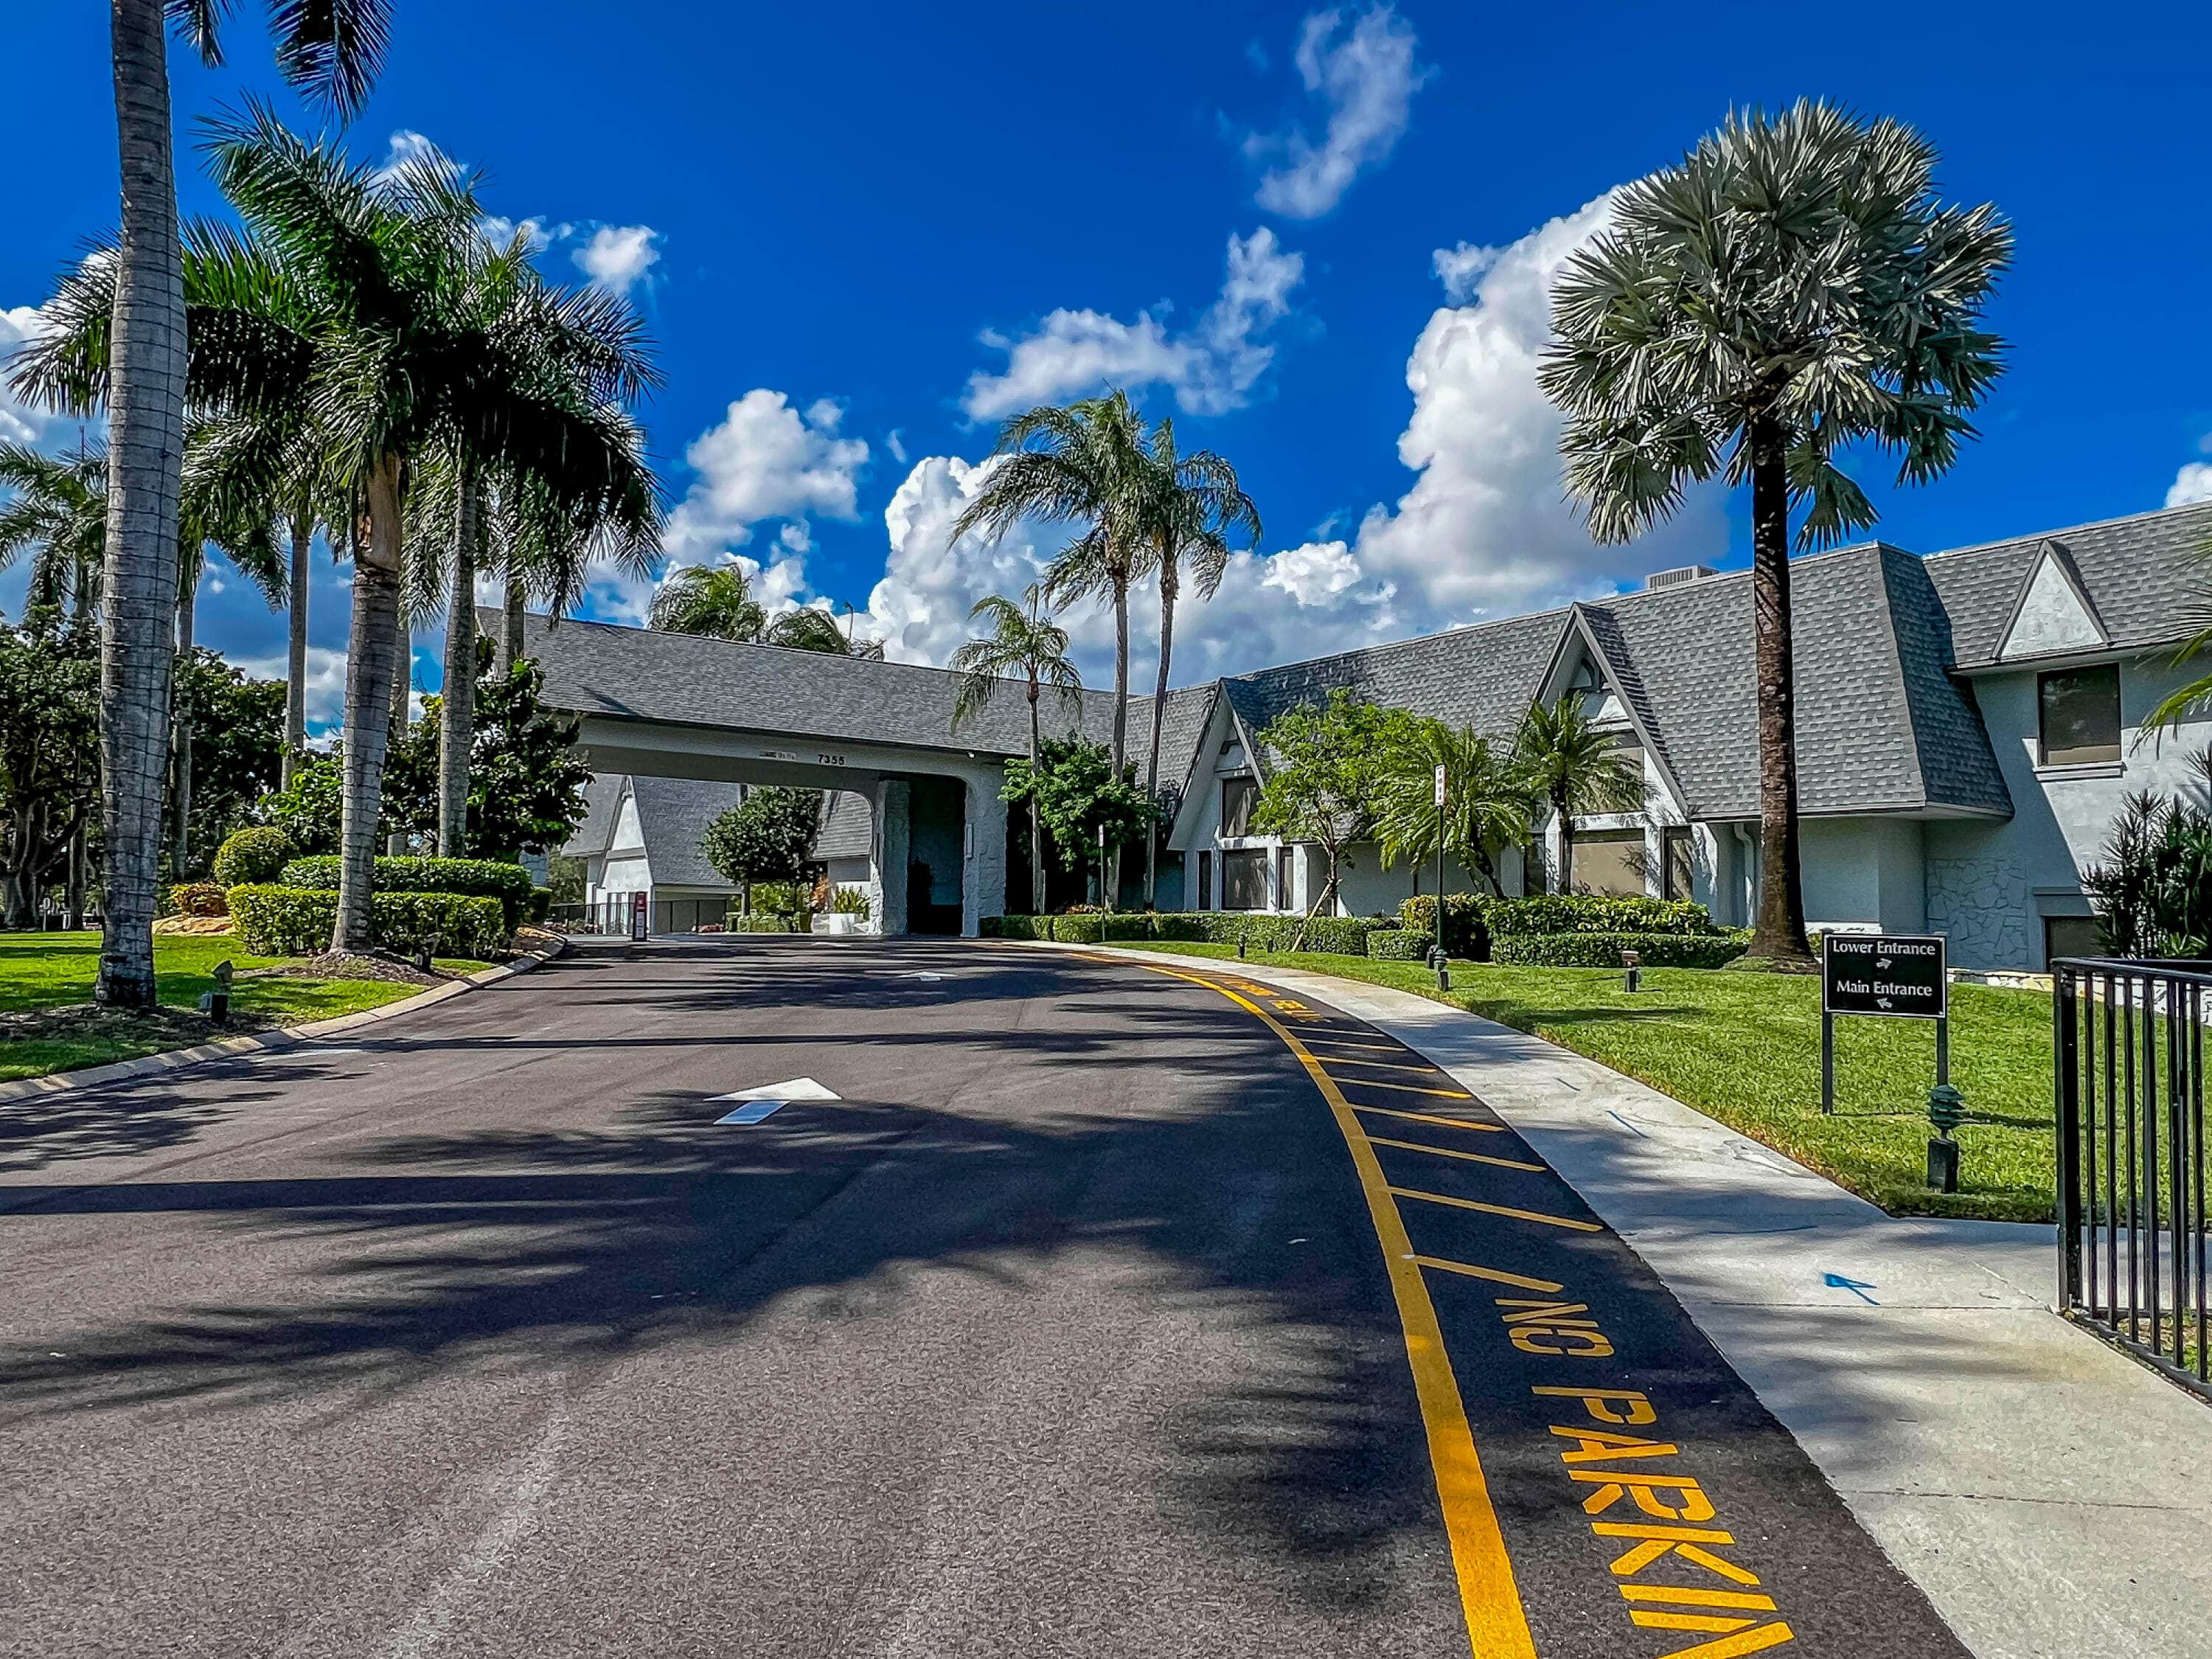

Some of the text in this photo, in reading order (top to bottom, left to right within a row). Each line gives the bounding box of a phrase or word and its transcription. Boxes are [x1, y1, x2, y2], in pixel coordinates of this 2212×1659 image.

[818, 754, 845, 765] 7355
[1833, 939, 1936, 956] Lower Entrance
[1837, 980, 1933, 996] Main Entrance
[1495, 1298, 1615, 1357] NO
